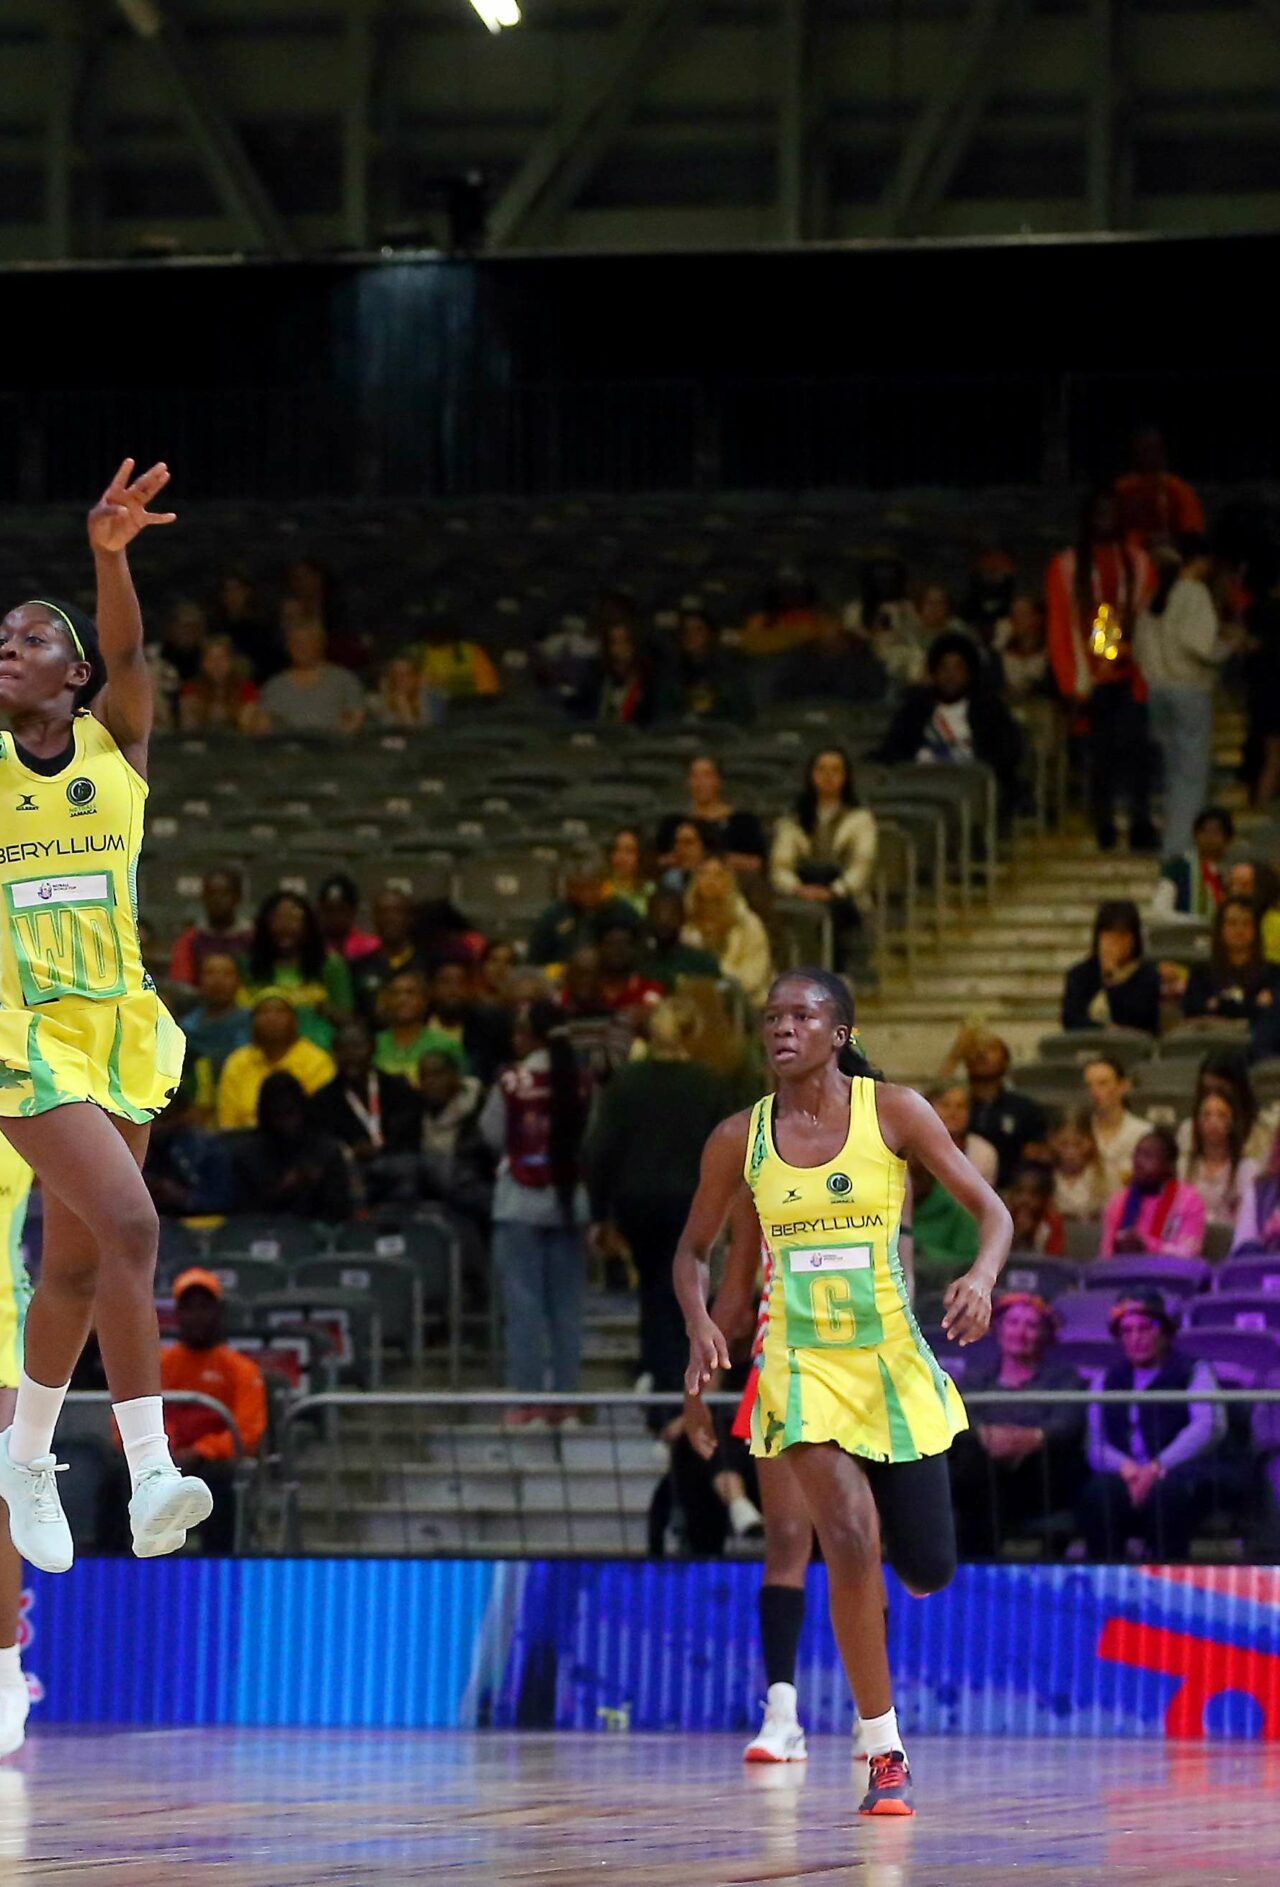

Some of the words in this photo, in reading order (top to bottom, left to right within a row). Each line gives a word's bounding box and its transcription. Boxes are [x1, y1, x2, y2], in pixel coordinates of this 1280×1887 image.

[70, 809, 98, 818] JAMAICA
[11, 907, 120, 993] WD
[771, 1213, 884, 1238] BERYLLIUM
[810, 1275, 856, 1345] C
